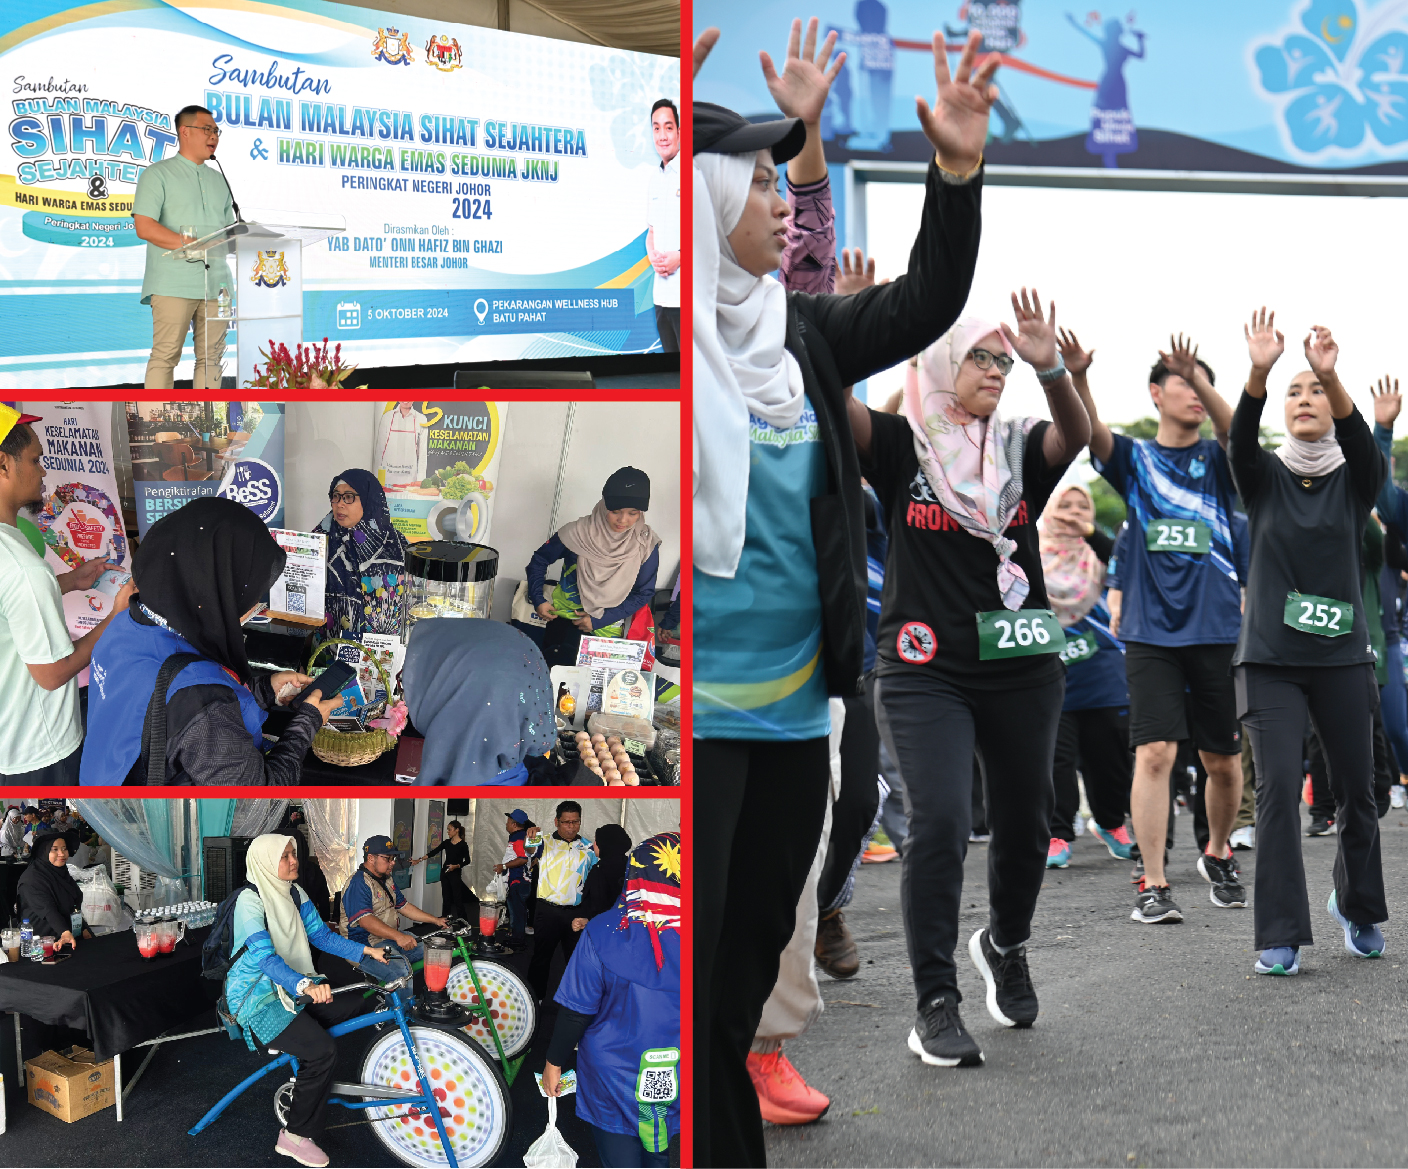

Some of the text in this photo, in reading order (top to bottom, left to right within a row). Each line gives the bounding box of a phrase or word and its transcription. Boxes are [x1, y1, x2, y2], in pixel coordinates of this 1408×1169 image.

[209, 53, 331, 95] Sambutan
[12, 75, 89, 94] Sambutan
[13, 98, 171, 129] BULAN MALAYSIA
[205, 89, 588, 157] BULAN MALAYSIA SIHAT SEJAHTERA
[9, 115, 178, 163] SIHAT
[250, 137, 559, 183] & HARI WARGA EMAS SEDUNIA JKNJ
[18, 159, 147, 184] SEJAHTE
[88, 175, 108, 199] &
[341, 175, 491, 197] PERINGKAT NEGERI JOHOR
[15, 192, 134, 212] HARI WARGA EMAS SEDU
[452, 198, 492, 220] 2024
[44, 216, 90, 231] Peringkat
[92, 219, 120, 232] Negeri
[383, 223, 430, 235] Dirasmikan
[431, 225, 450, 235] Oleh
[81, 236, 114, 247] 2024
[327, 237, 350, 251] YAB
[391, 238, 415, 252] ONN
[418, 238, 449, 253] HAFIZ
[452, 239, 470, 253] BIN
[473, 240, 503, 254] GHAZI
[369, 256, 468, 269] MENTERI BESAR JOHOR
[367, 308, 449, 320] 5 OKTOBER 2024
[493, 298, 618, 311] PEKARANGAN WELLNESS HUB
[493, 312, 547, 323] BATU PAHAT
[63, 418, 77, 426] HARI
[443, 415, 488, 429] KUNCI
[428, 440, 476, 450] MAKANAN
[430, 430, 488, 441] KESELAMATAN
[47, 439, 103, 458] MAKANAN
[43, 456, 109, 475] SEDUNIA 2024
[144, 486, 213, 498] Pengiktirafan
[226, 479, 272, 503] BeSS
[1157, 525, 1198, 547] 251
[1298, 602, 1342, 630] 252
[995, 617, 1050, 649] 266
